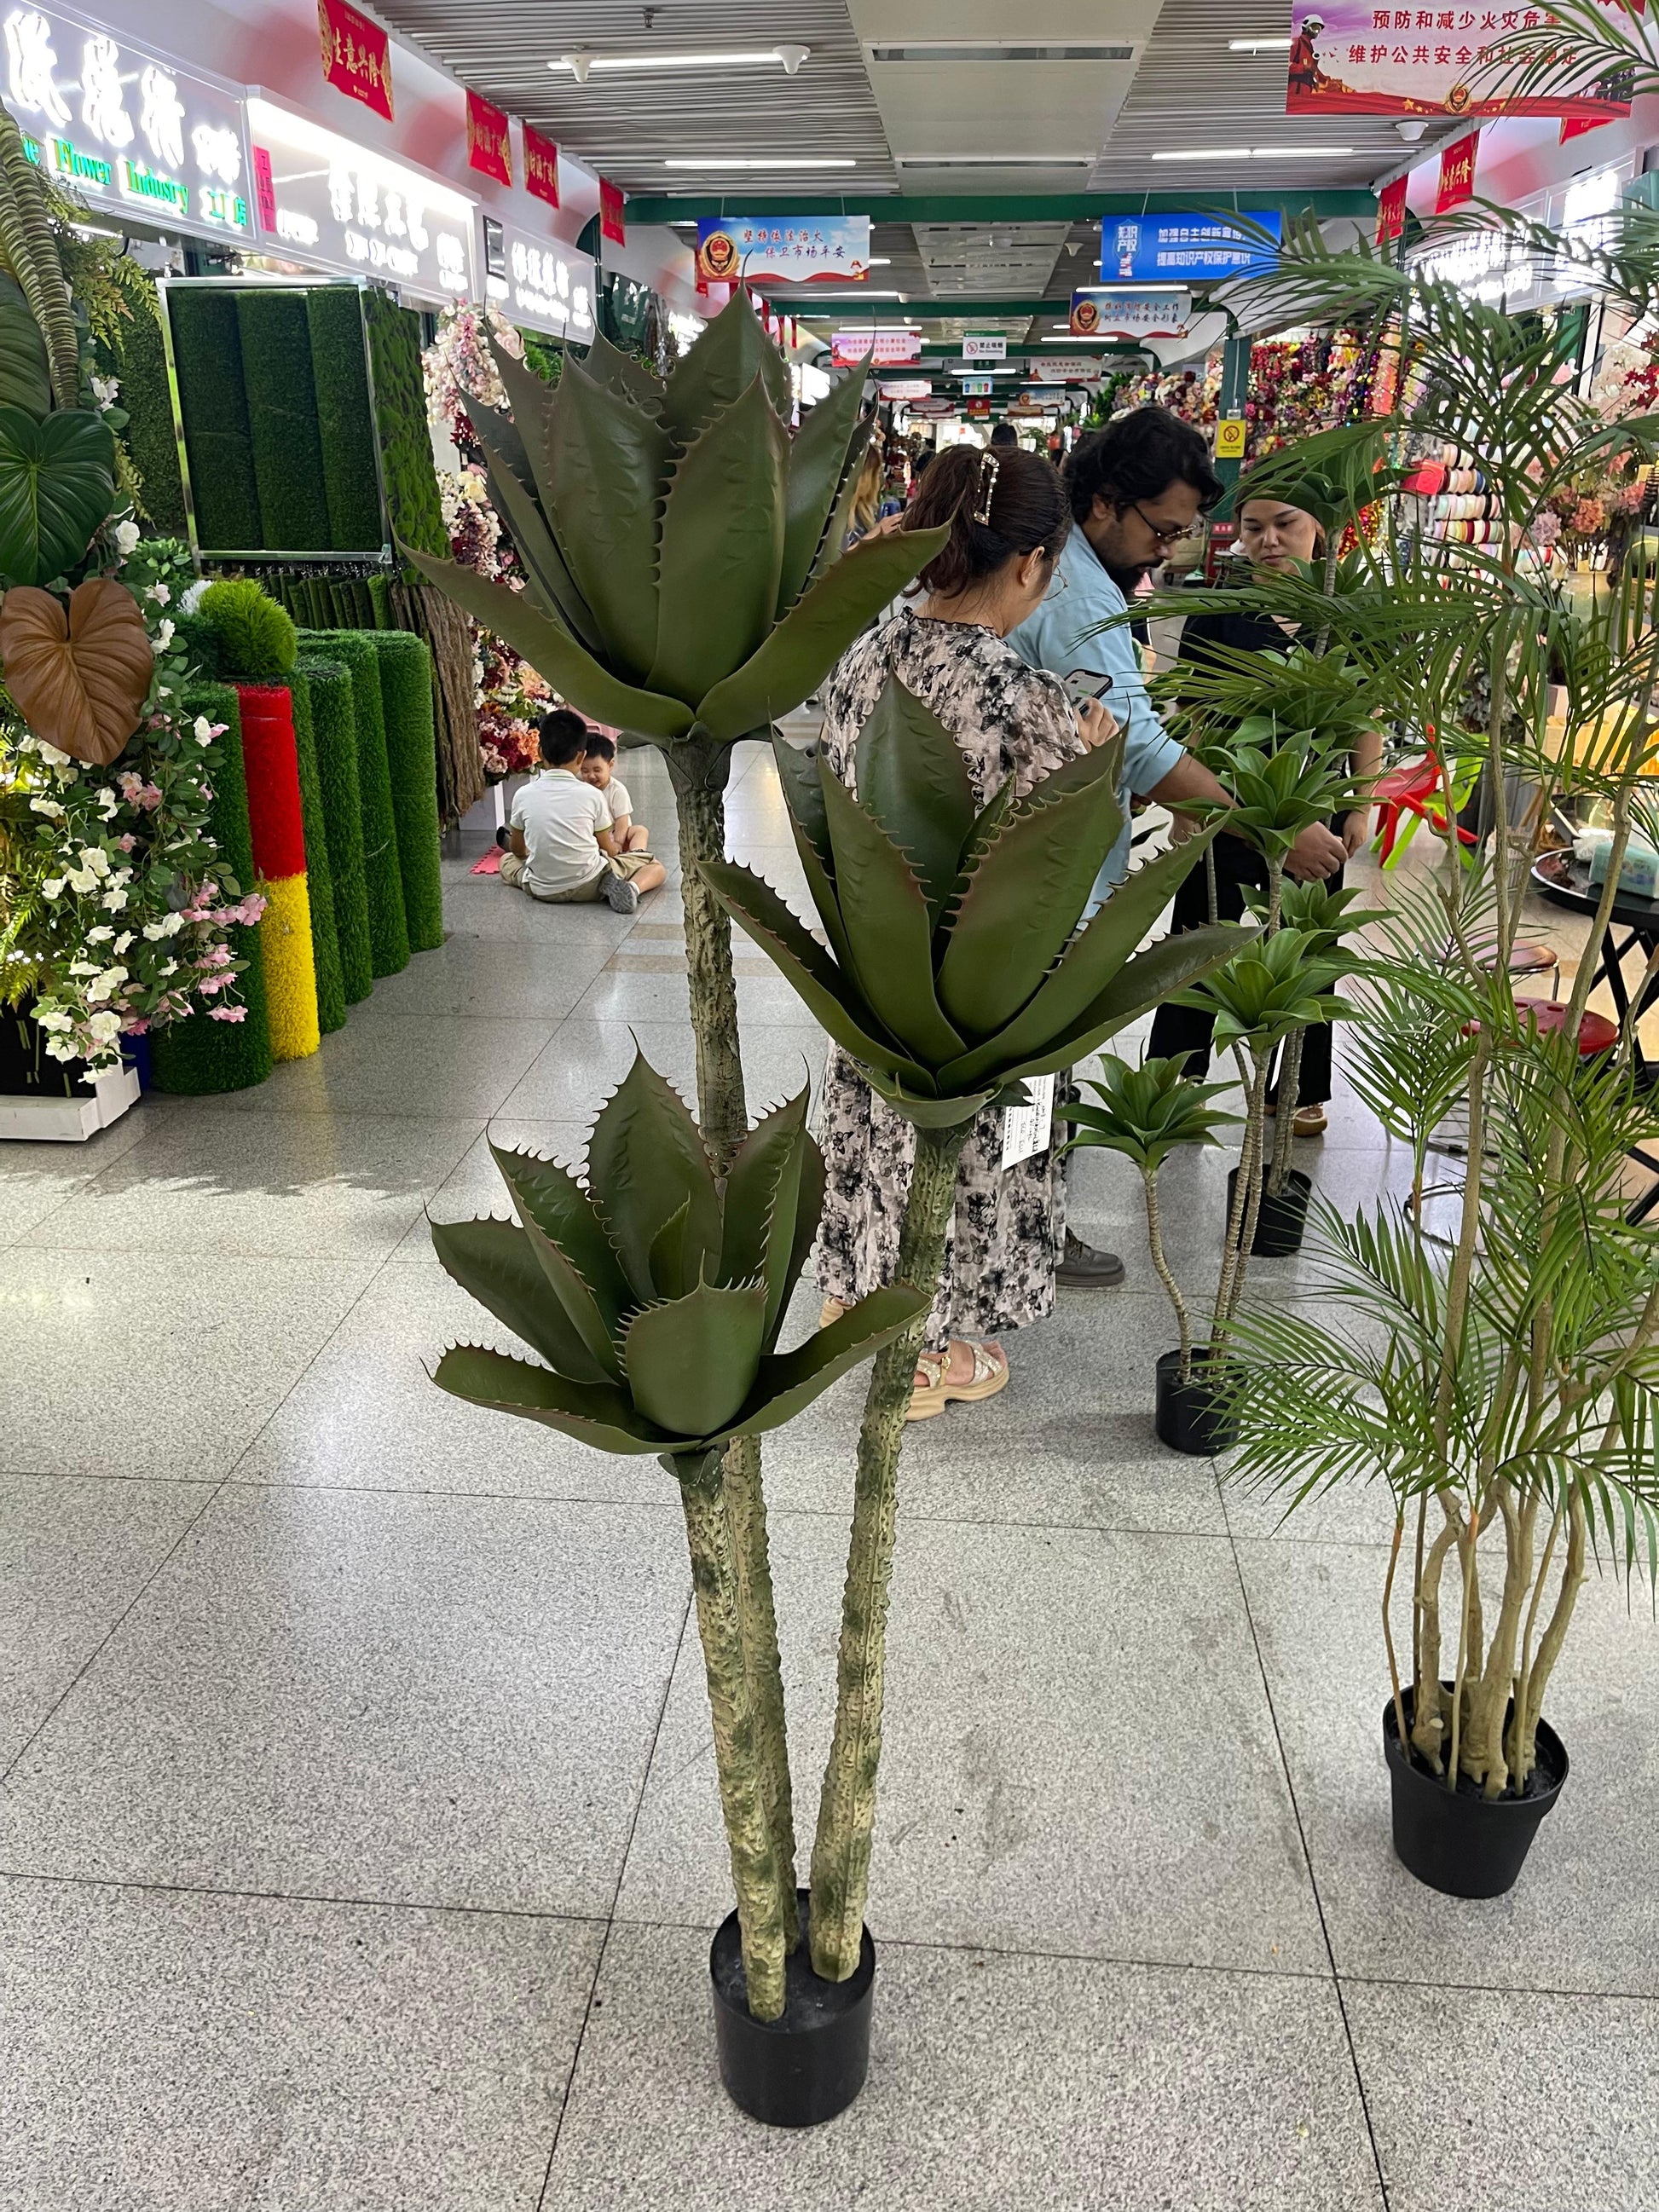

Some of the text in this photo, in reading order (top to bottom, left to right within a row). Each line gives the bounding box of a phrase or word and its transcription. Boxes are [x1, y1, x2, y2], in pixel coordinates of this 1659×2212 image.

[1373, 10, 1562, 30] 预防和减少火灾危害
[333, 26, 380, 87] 生意兴隆
[54, 138, 112, 186] Flower
[126, 160, 189, 214] Industry
[765, 245, 846, 259] 保卫市场平安
[1157, 251, 1251, 266] 提高知识产权保护意识
